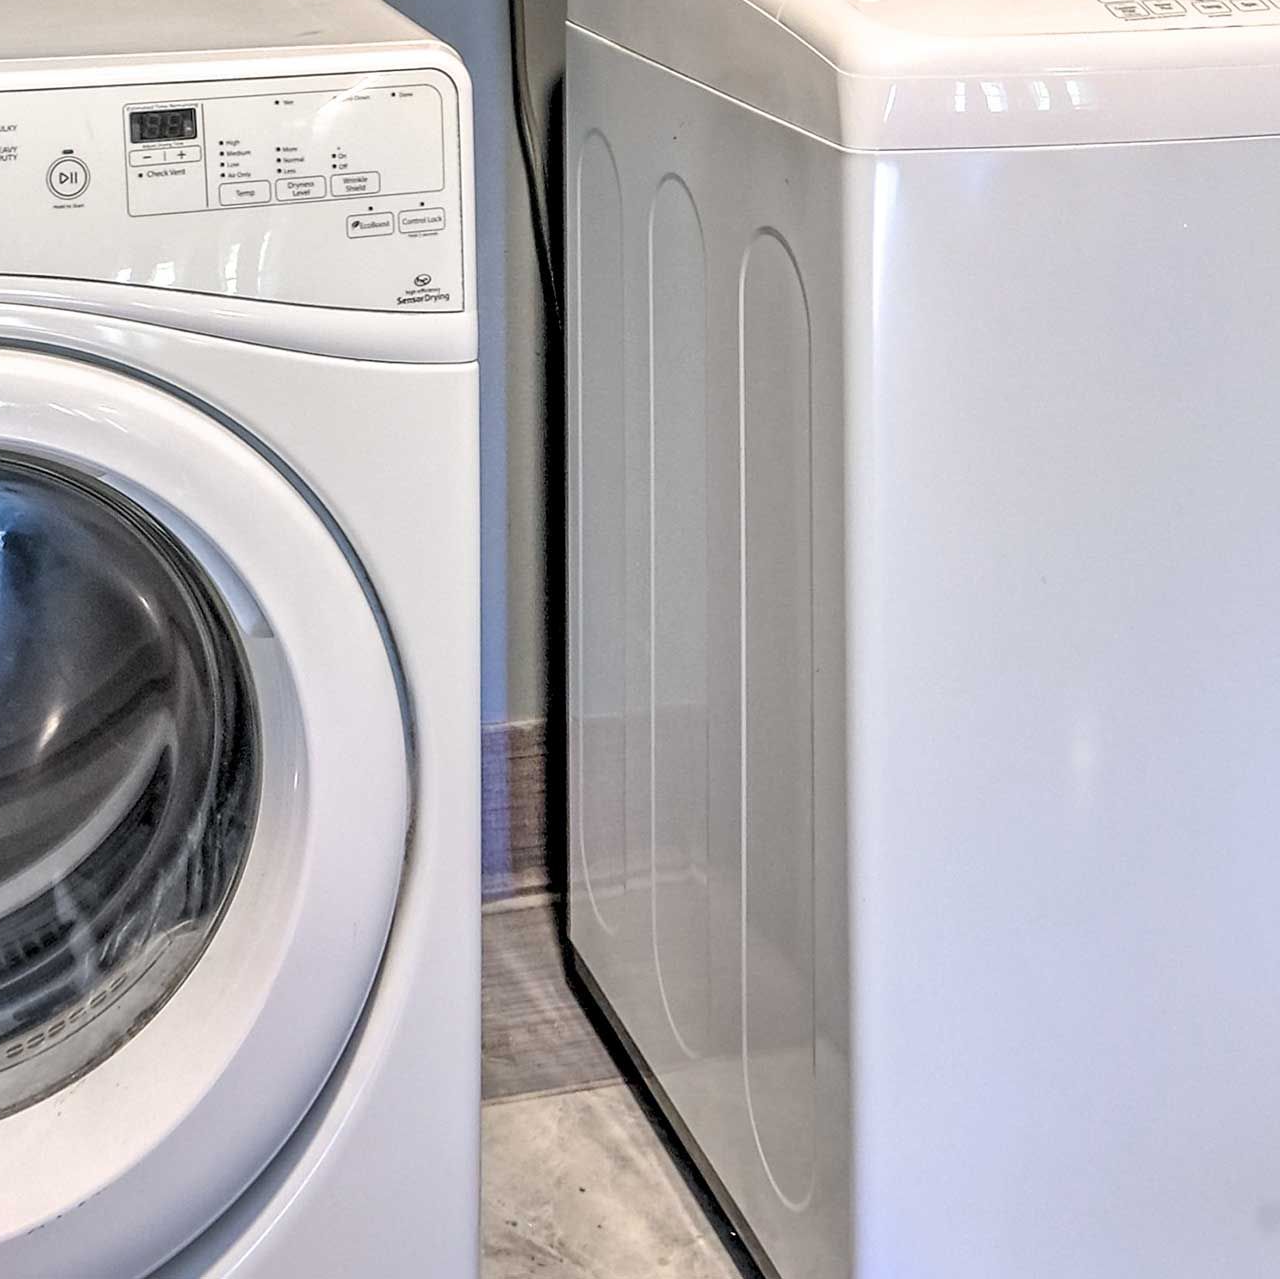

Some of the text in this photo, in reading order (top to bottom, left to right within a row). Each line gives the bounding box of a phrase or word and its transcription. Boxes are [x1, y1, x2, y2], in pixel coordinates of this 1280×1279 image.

[146, 168, 186, 178] Check Vent
[343, 176, 368, 184] Wrinkle
[287, 181, 314, 190] Dryness
[346, 184, 366, 192] Shield
[236, 189, 256, 198] Temp
[292, 189, 310, 197] Level
[402, 215, 442, 225] Control Lock
